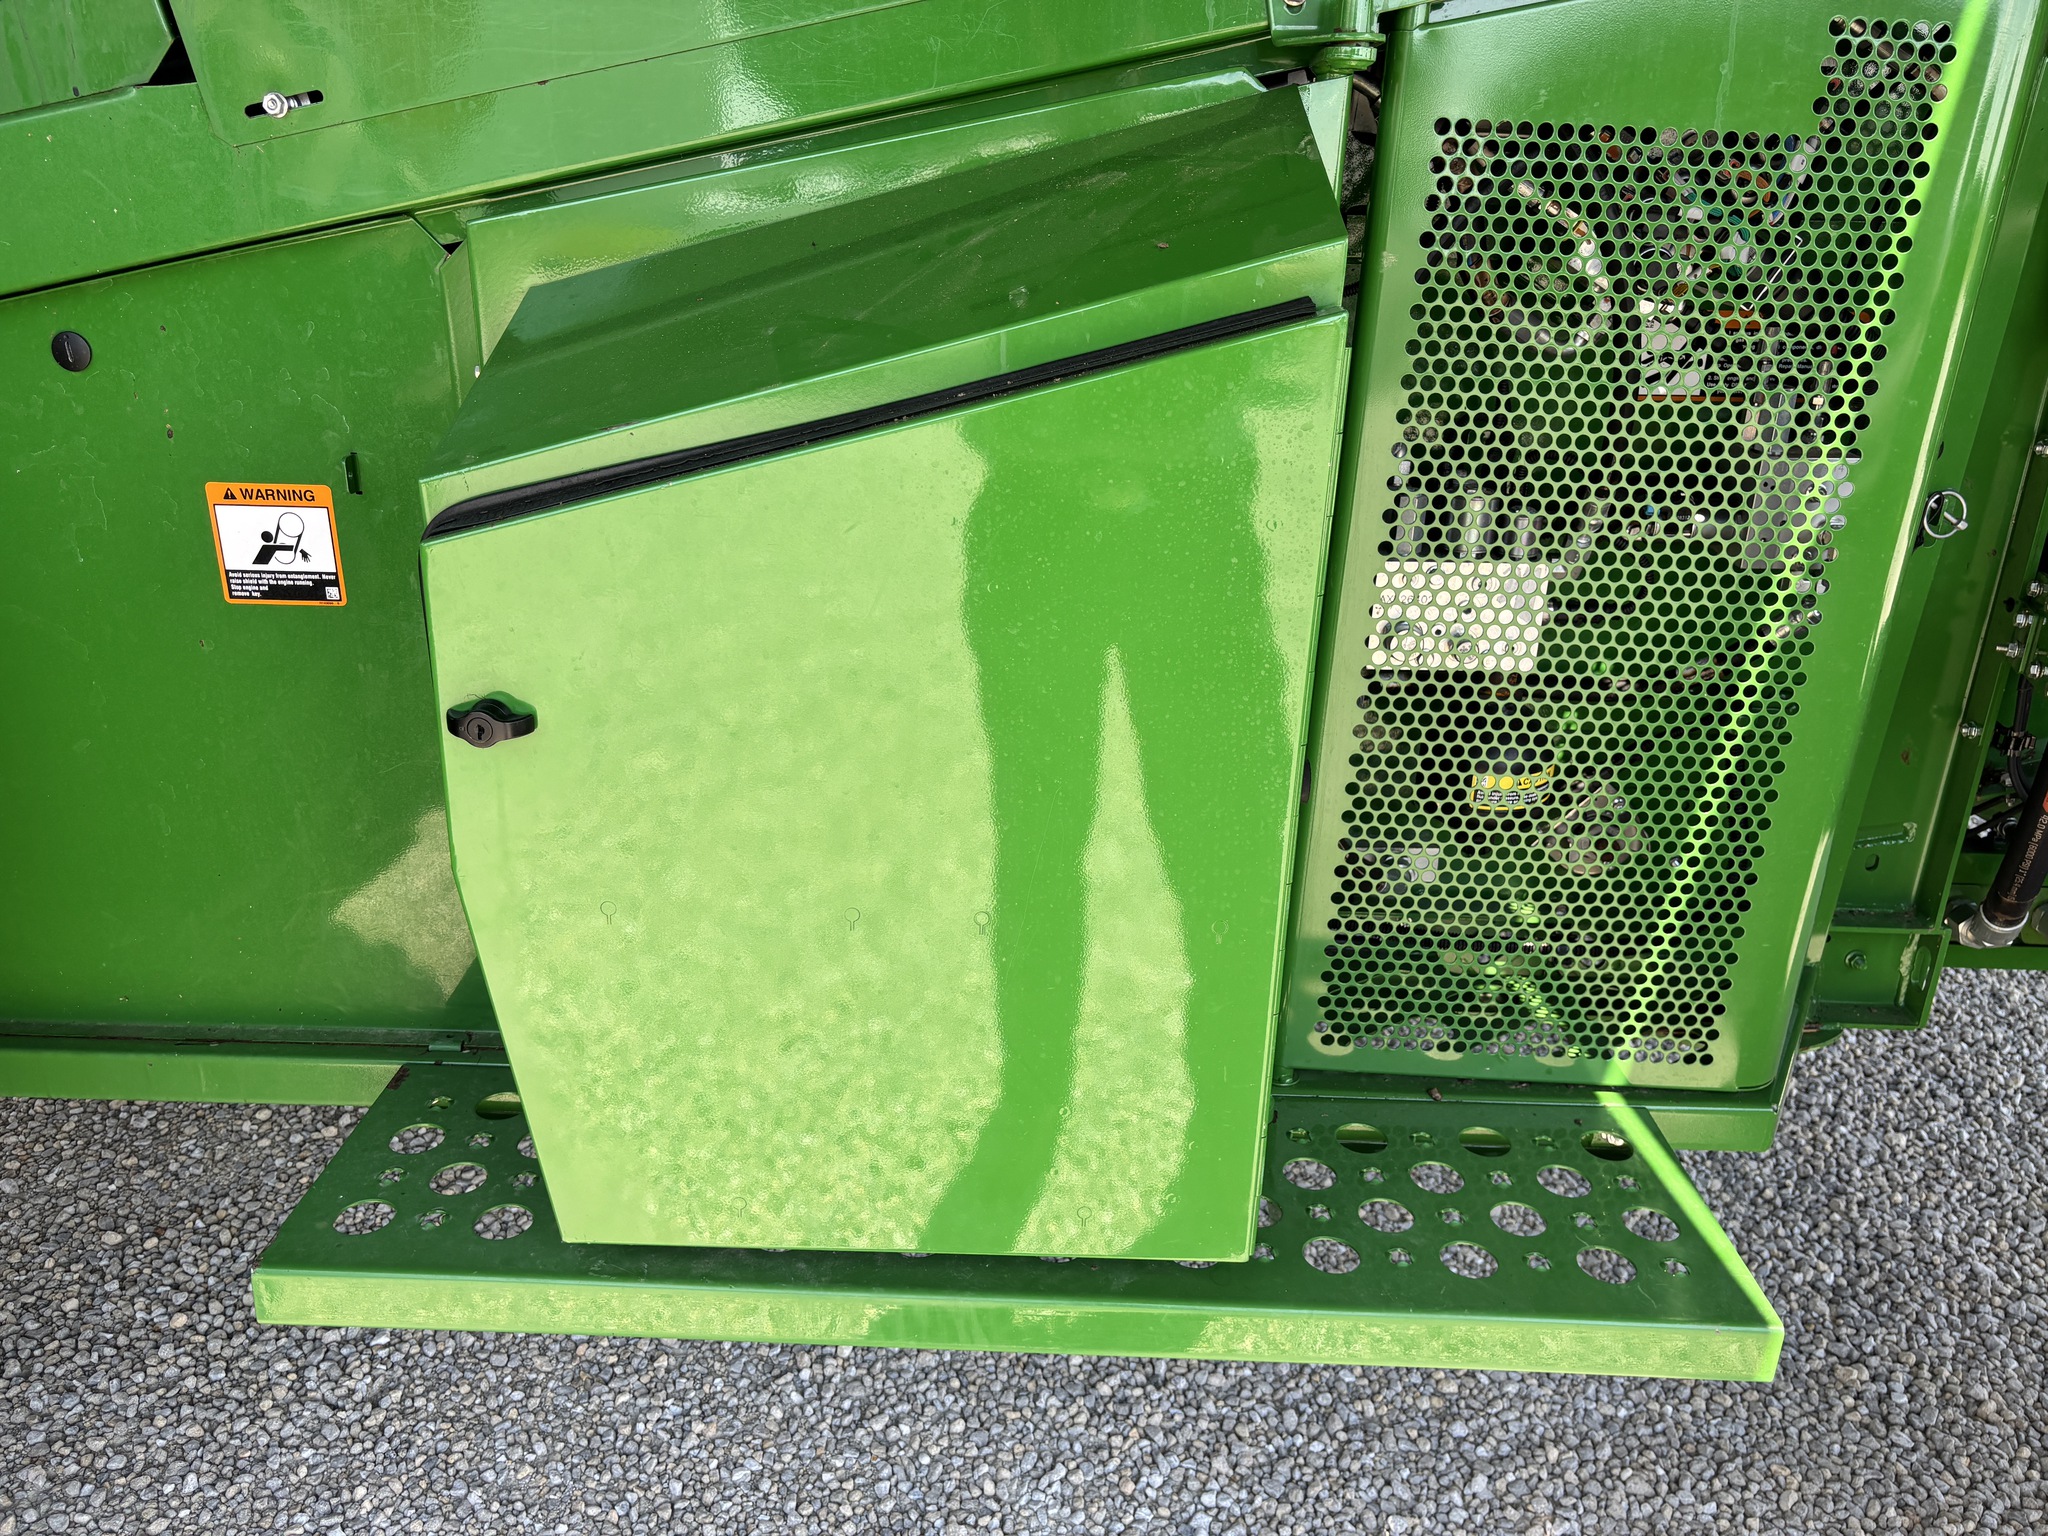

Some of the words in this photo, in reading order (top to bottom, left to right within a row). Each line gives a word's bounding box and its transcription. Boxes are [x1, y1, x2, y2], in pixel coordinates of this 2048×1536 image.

[239, 488, 315, 502] WARNING
[261, 572, 275, 580] injury
[287, 573, 321, 581] entanglement.
[251, 590, 262, 598] key.
